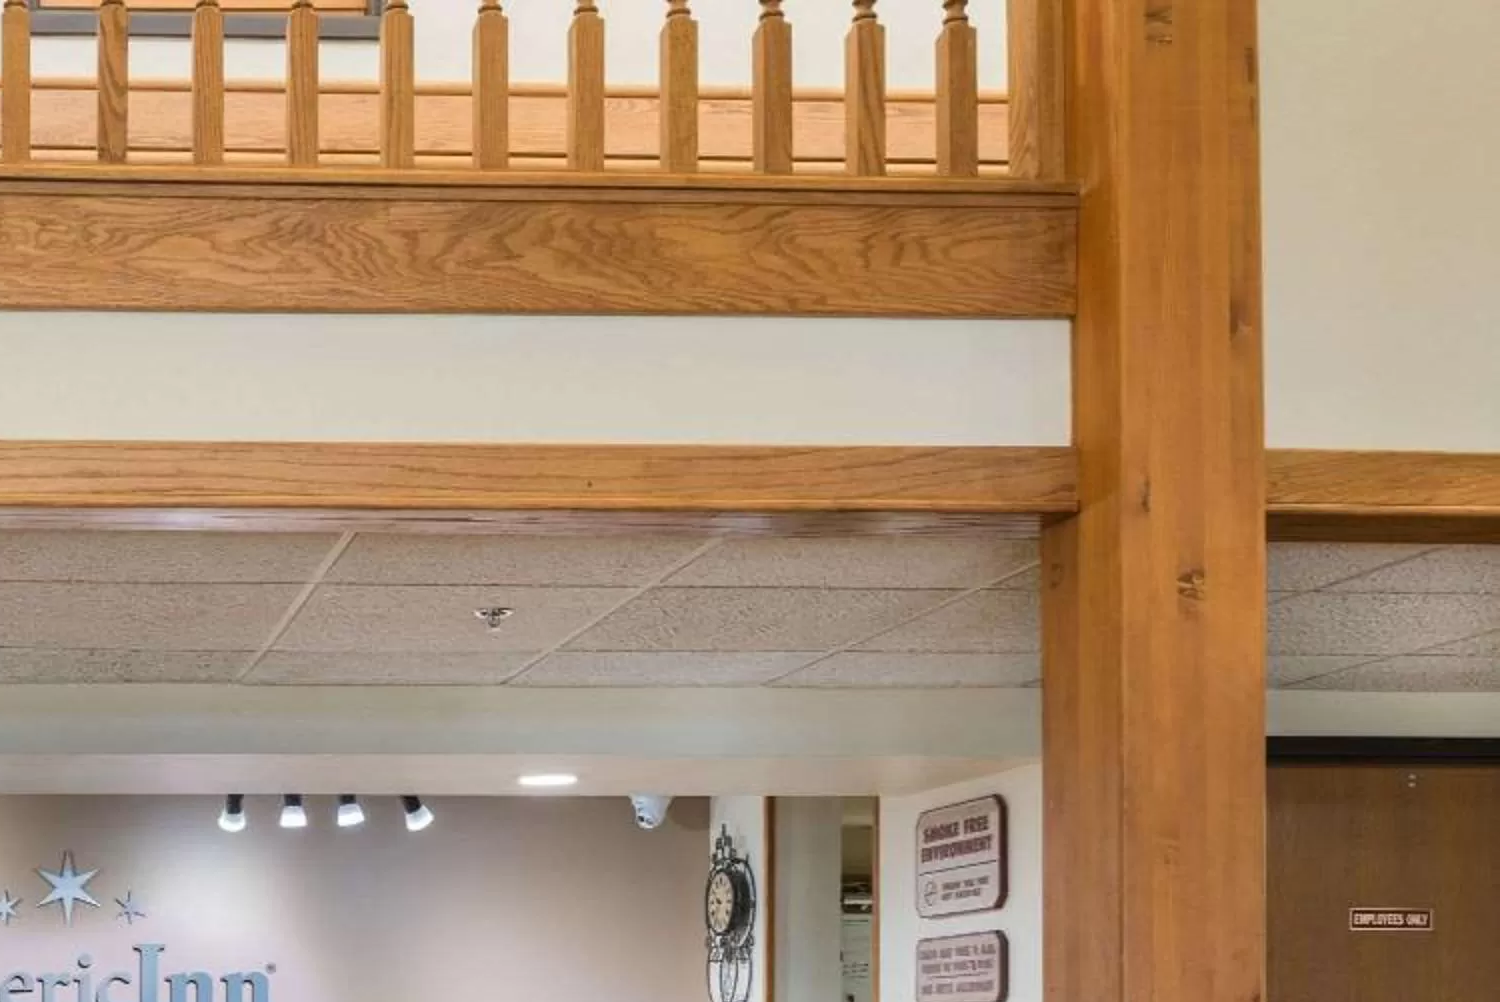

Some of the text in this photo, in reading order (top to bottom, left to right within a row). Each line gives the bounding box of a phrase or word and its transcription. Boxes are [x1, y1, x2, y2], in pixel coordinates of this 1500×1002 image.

[963, 815, 989, 834] FREE
[1353, 913, 1429, 925] EMPLOYEES ONLY
